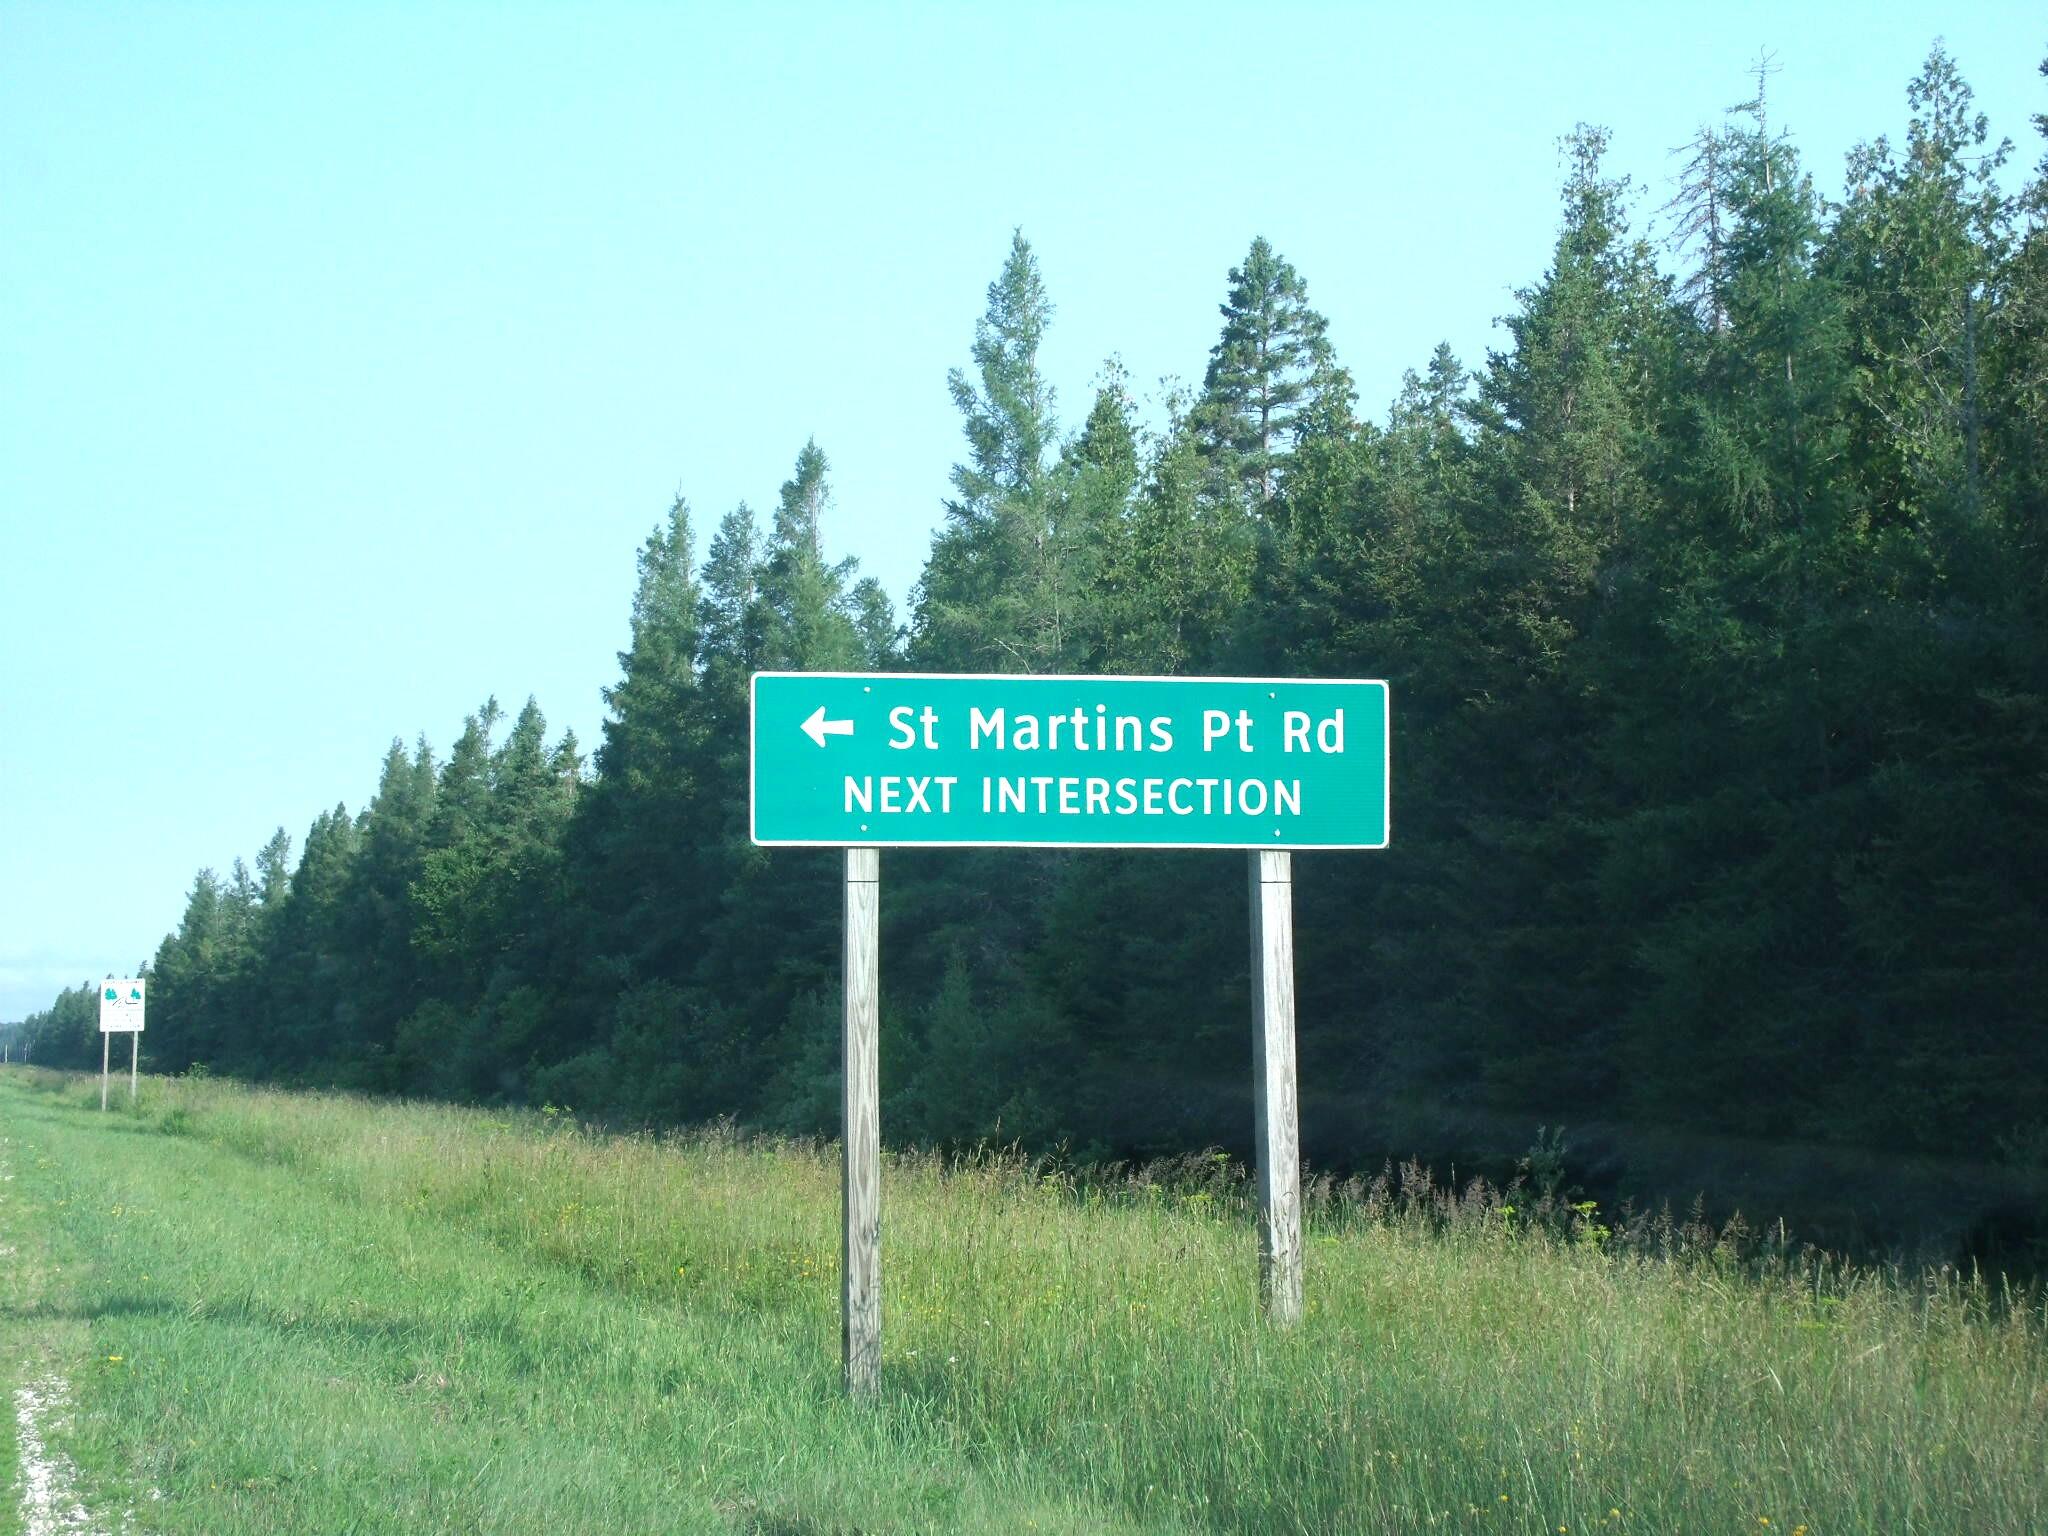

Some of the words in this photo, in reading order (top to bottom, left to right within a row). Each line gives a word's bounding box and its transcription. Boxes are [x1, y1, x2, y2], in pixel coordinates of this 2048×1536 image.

[888, 705, 939, 750] St
[970, 703, 1173, 753] Martins
[1203, 709, 1254, 753] Pt
[1283, 708, 1345, 754] Rd
[844, 775, 958, 813] NEXT
[983, 776, 1301, 816] INTERSECTION
